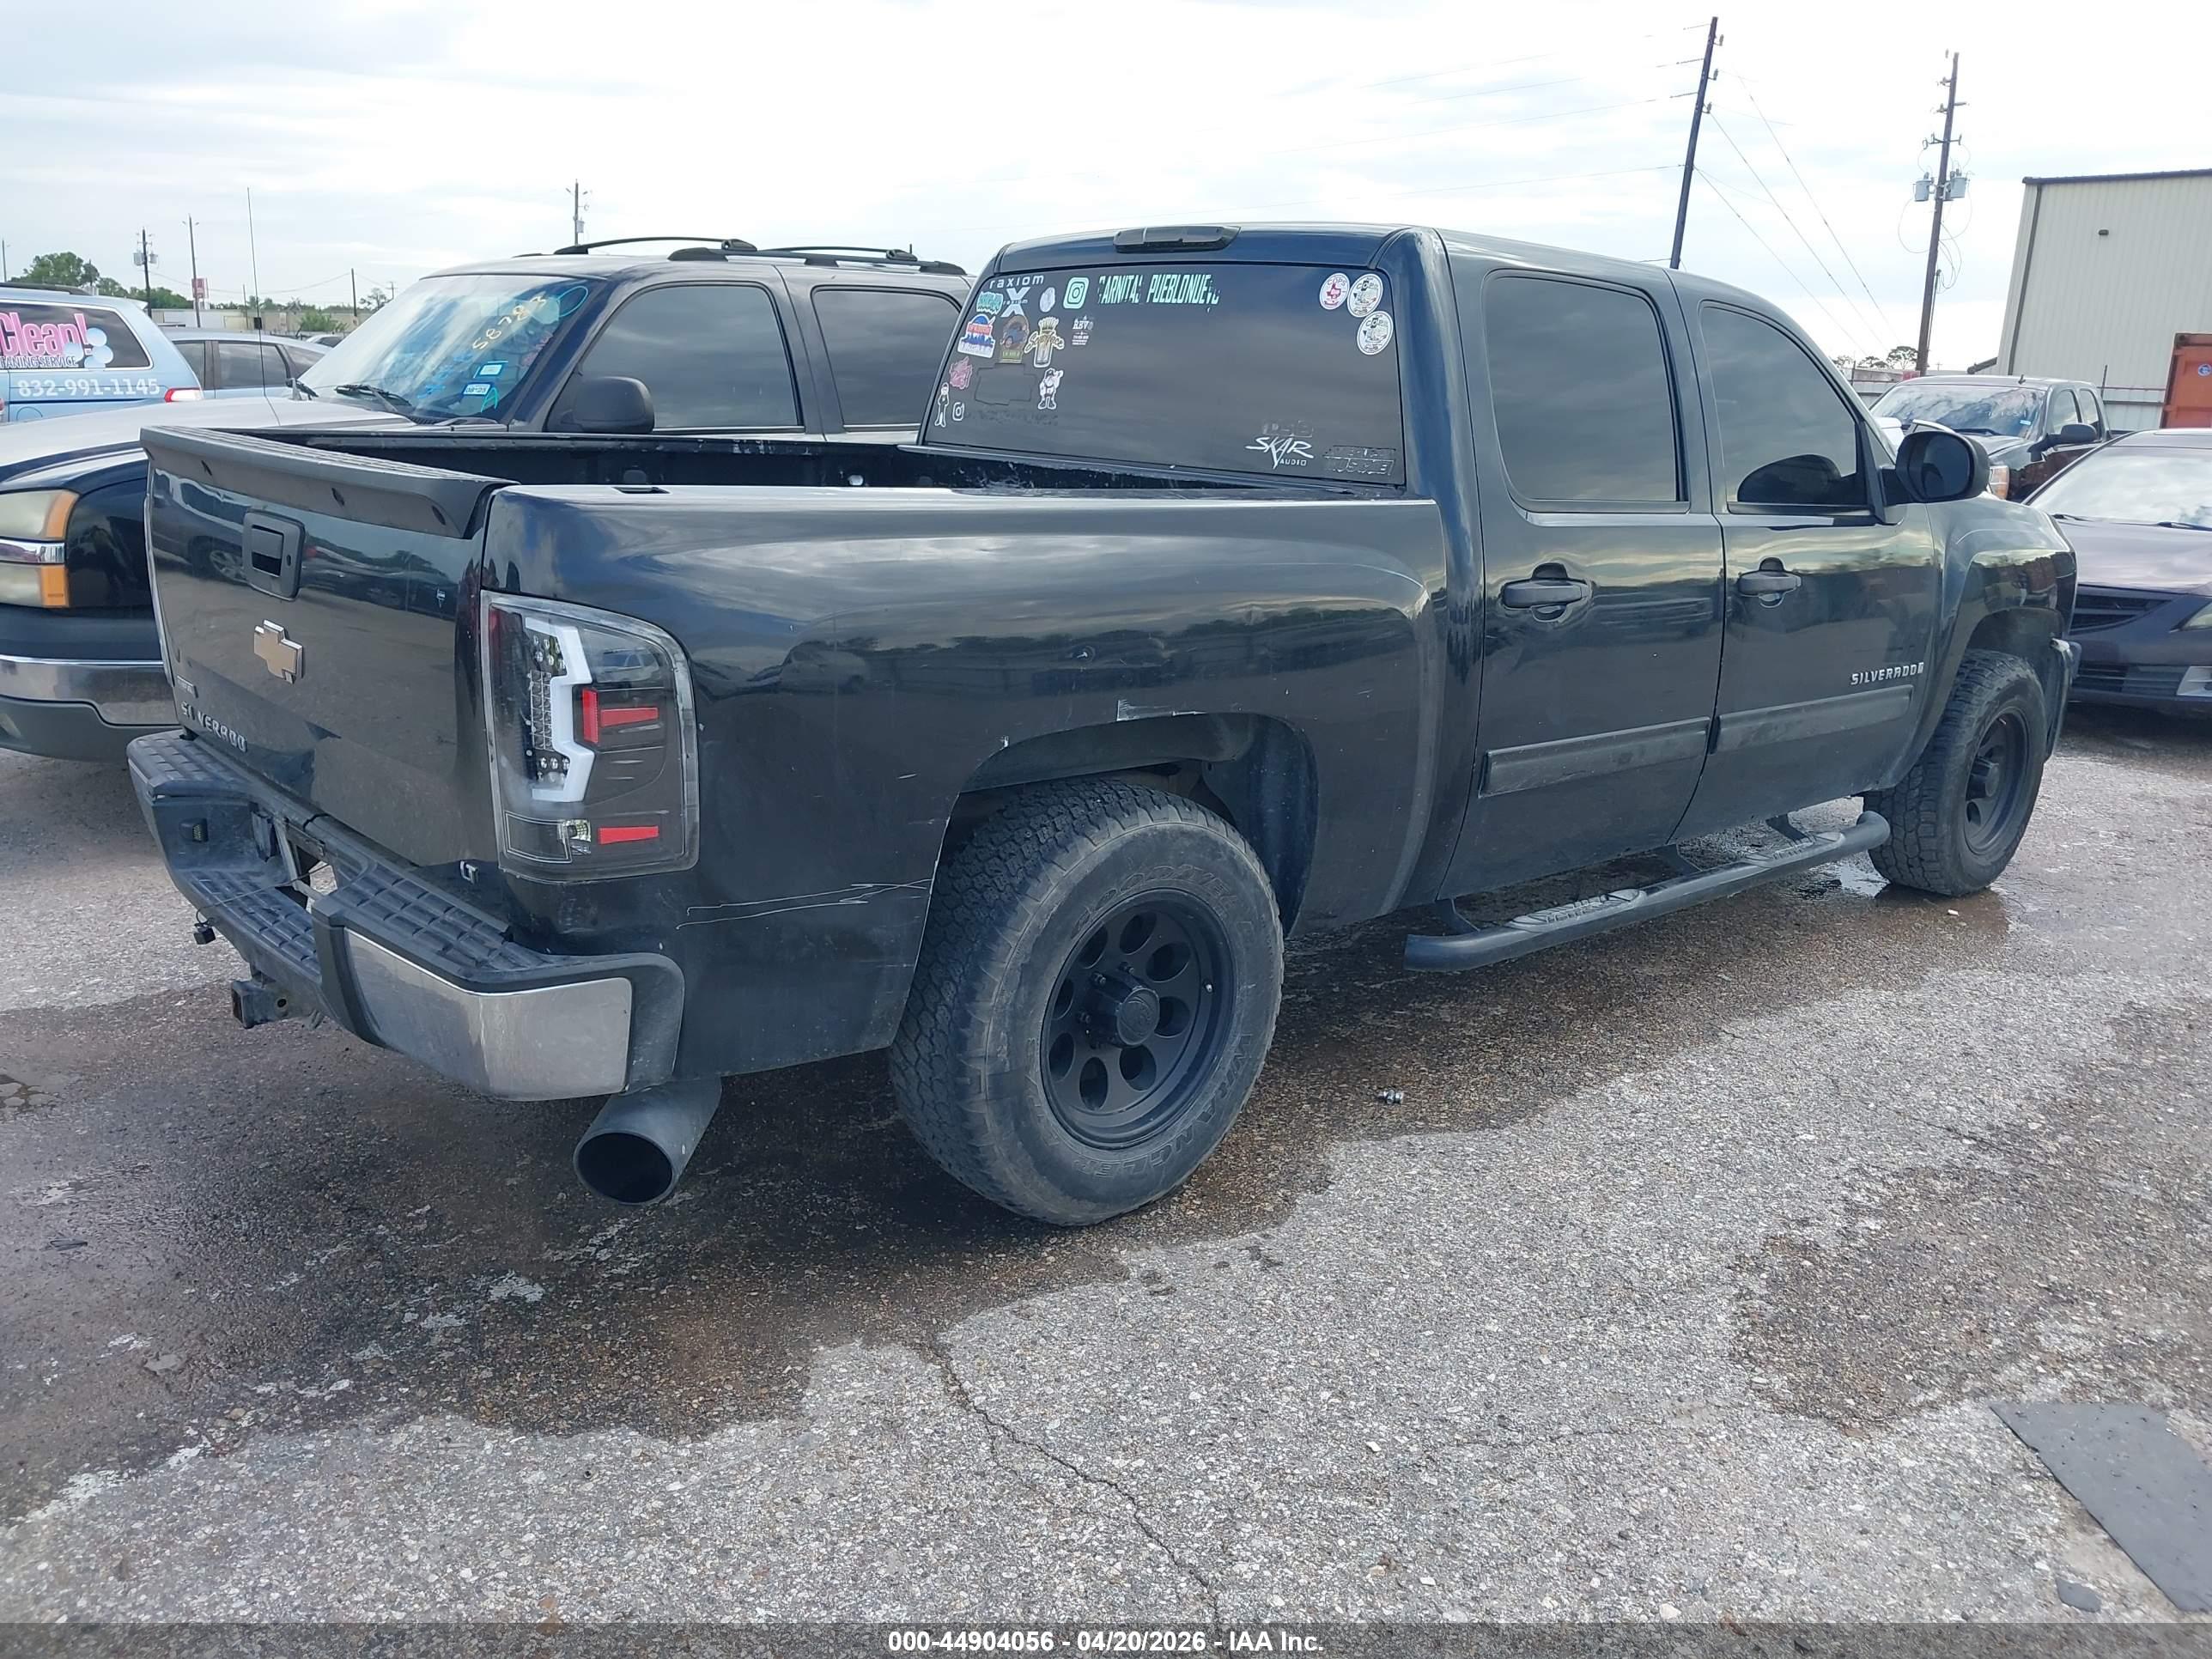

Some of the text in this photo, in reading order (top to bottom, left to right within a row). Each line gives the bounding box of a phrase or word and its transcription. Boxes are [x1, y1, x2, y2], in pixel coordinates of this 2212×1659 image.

[989, 275, 1044, 289] raxiom
[1327, 277, 1347, 286] COPS
[39, 355, 79, 368] SERVICE
[16, 378, 161, 398] 832-991-1145
[1245, 436, 1314, 469] SKAR
[1850, 664, 1917, 685] SILVERADO
